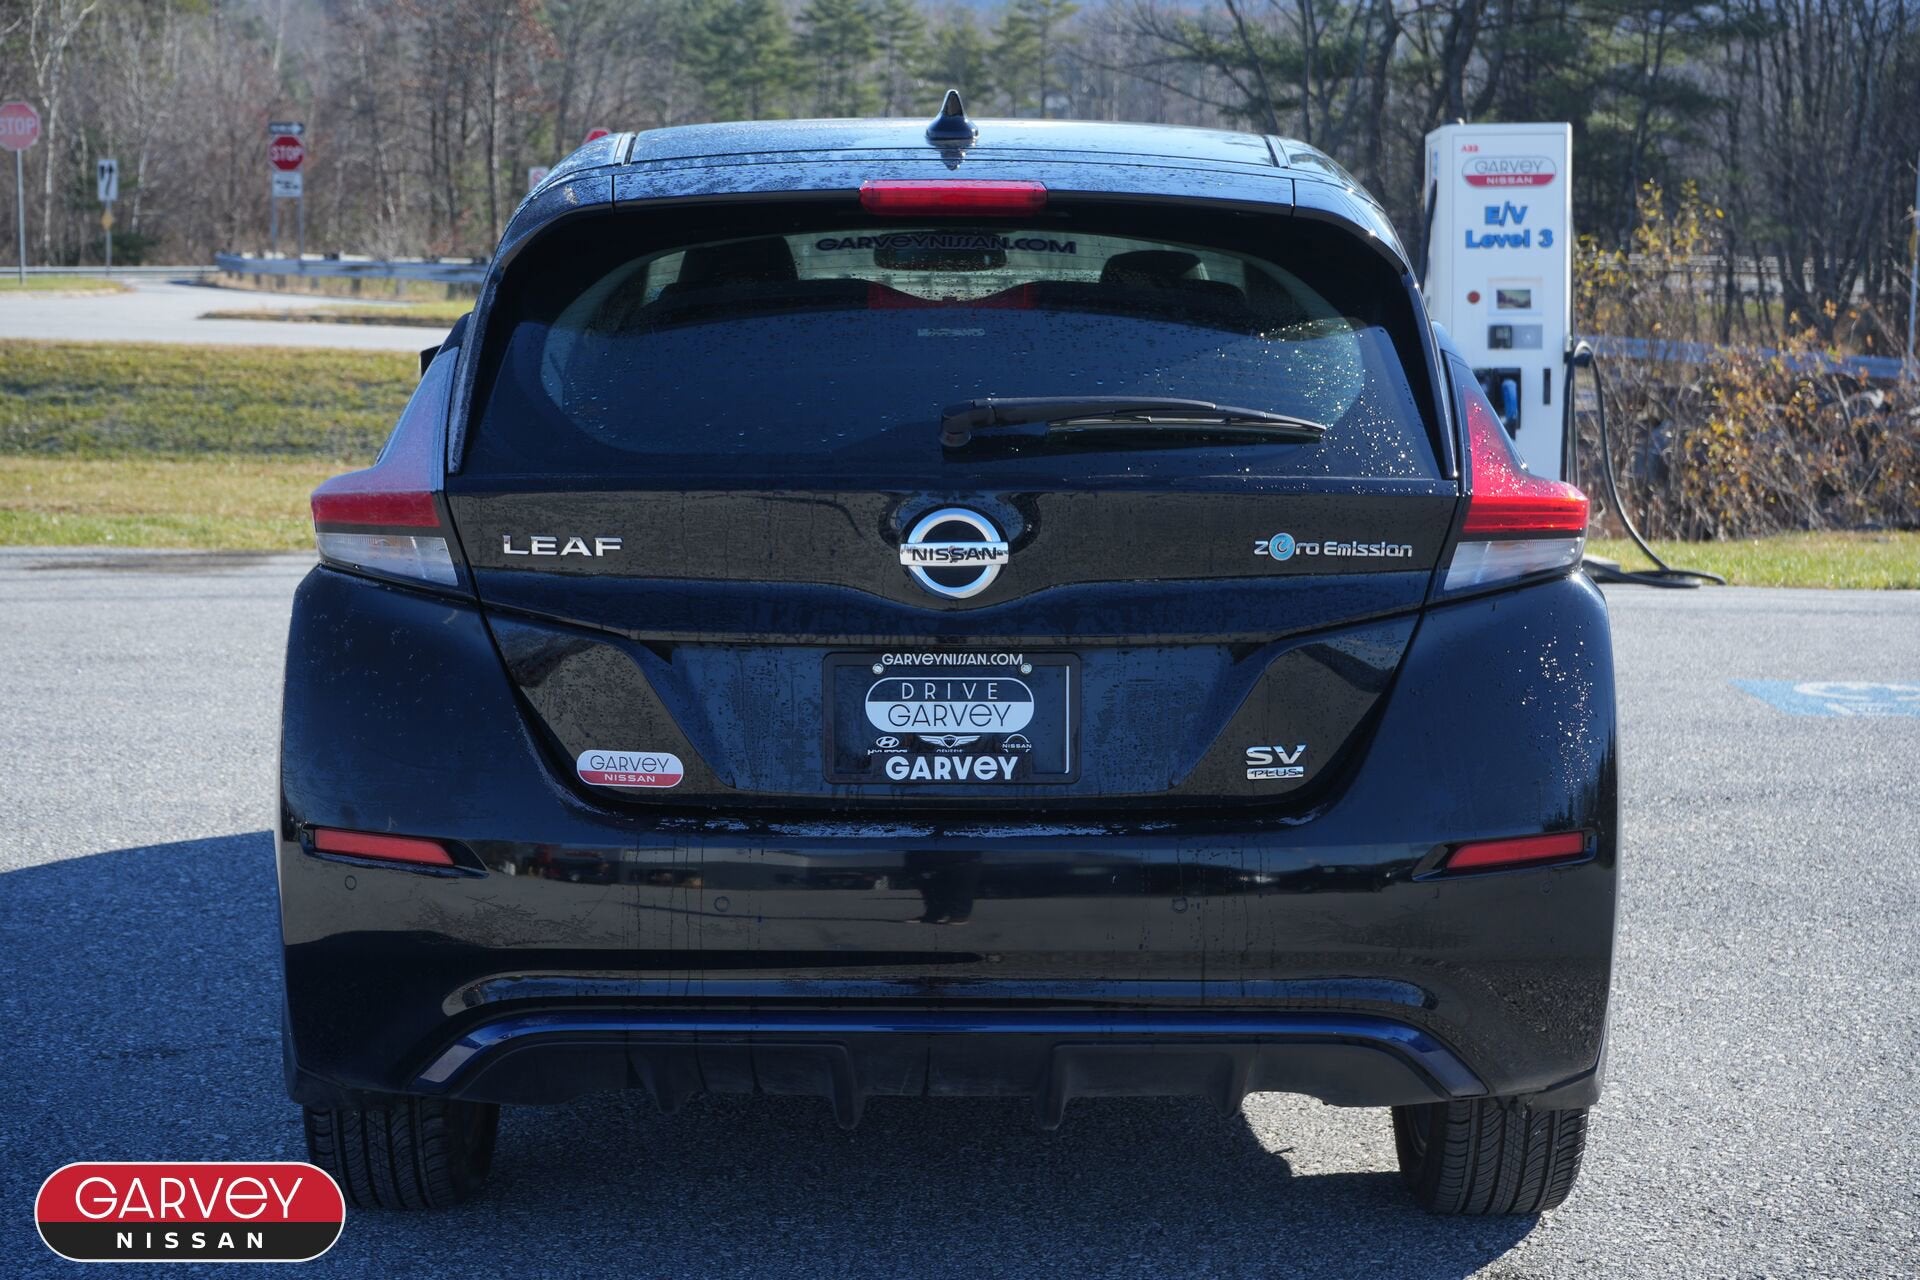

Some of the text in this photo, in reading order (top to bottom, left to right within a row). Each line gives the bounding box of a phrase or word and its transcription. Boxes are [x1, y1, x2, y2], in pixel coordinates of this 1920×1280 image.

[271, 146, 303, 161] STOP
[1475, 160, 1542, 174] GARVEY
[1486, 176, 1533, 185] NISSAN
[1484, 201, 1528, 226] E/V
[815, 235, 1077, 254] GARVEYNISSAN.COM
[1465, 229, 1554, 248] Level 3
[502, 535, 622, 557] LEAF
[912, 547, 997, 562] NISSAN
[1323, 541, 1413, 557] Emission
[881, 653, 1023, 666] GARVEYNISSAN.COM
[901, 682, 998, 700] DRIVE
[888, 704, 1011, 727] GARVEY
[1246, 744, 1306, 765] SV
[590, 755, 669, 772] GARVEY
[885, 756, 1018, 780] GARVEY
[604, 773, 655, 783] NISSAN
[1252, 768, 1298, 777] PLUS
